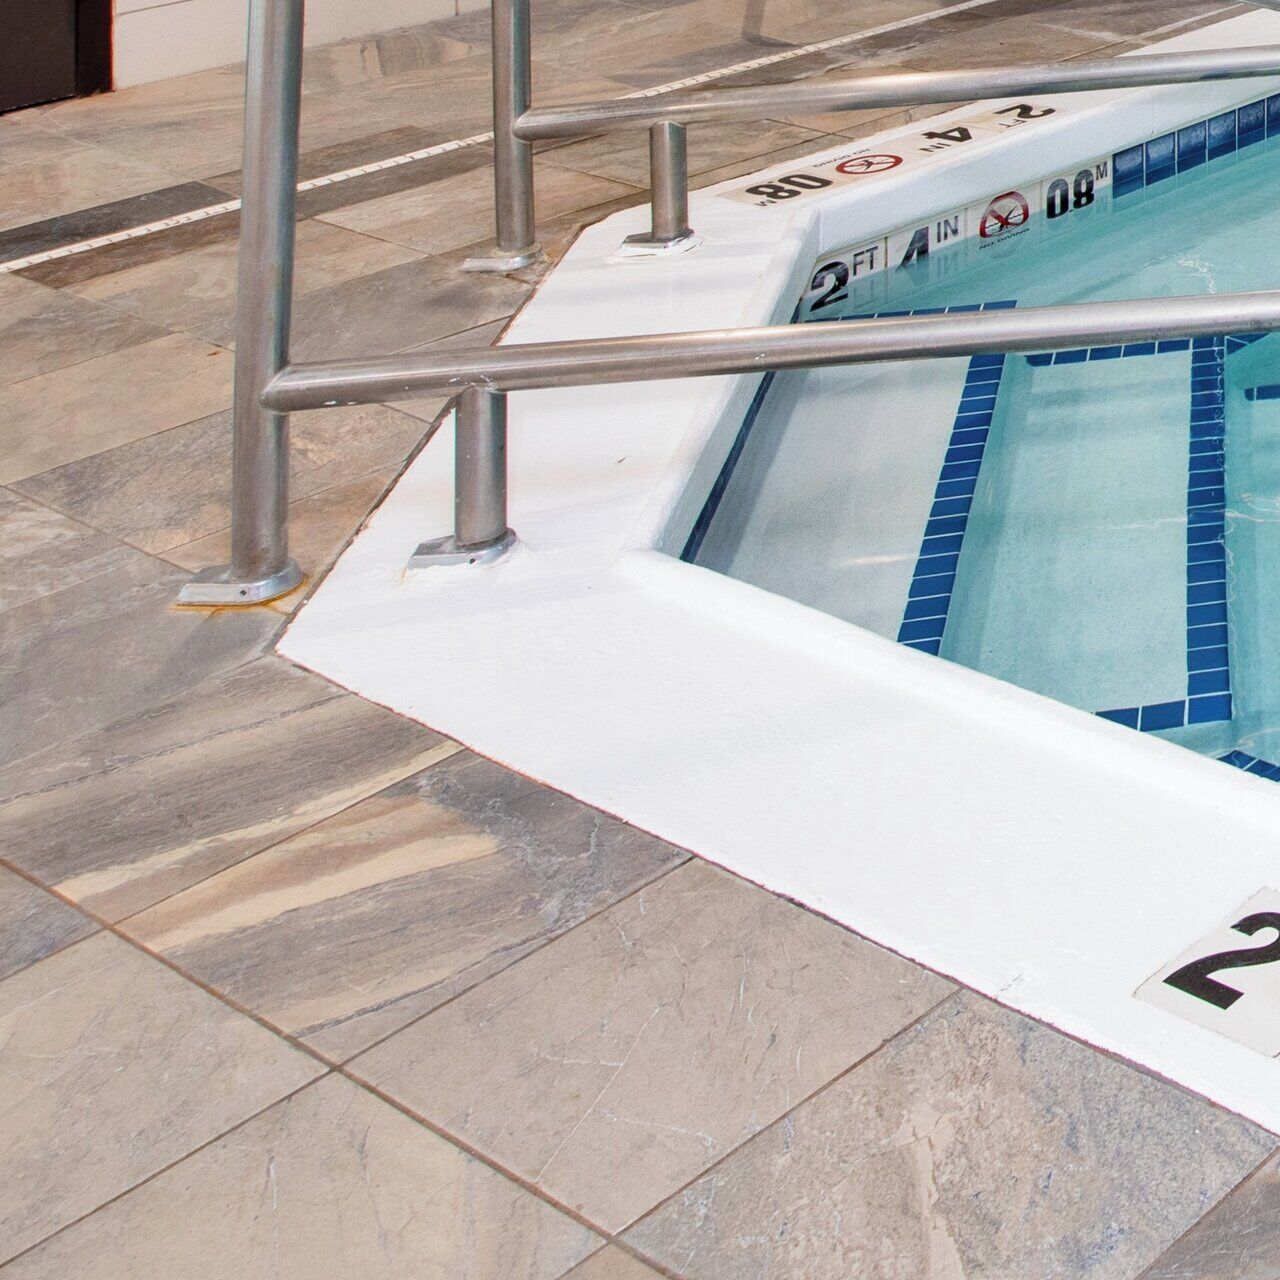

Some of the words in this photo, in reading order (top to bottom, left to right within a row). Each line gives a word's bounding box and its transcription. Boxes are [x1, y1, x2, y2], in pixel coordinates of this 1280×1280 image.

[993, 103, 1056, 119] 2
[921, 126, 973, 143] 4
[918, 142, 952, 153] IN
[1095, 161, 1108, 181] M
[809, 261, 850, 312] 2
[853, 245, 879, 276] FT
[936, 215, 959, 244] IN
